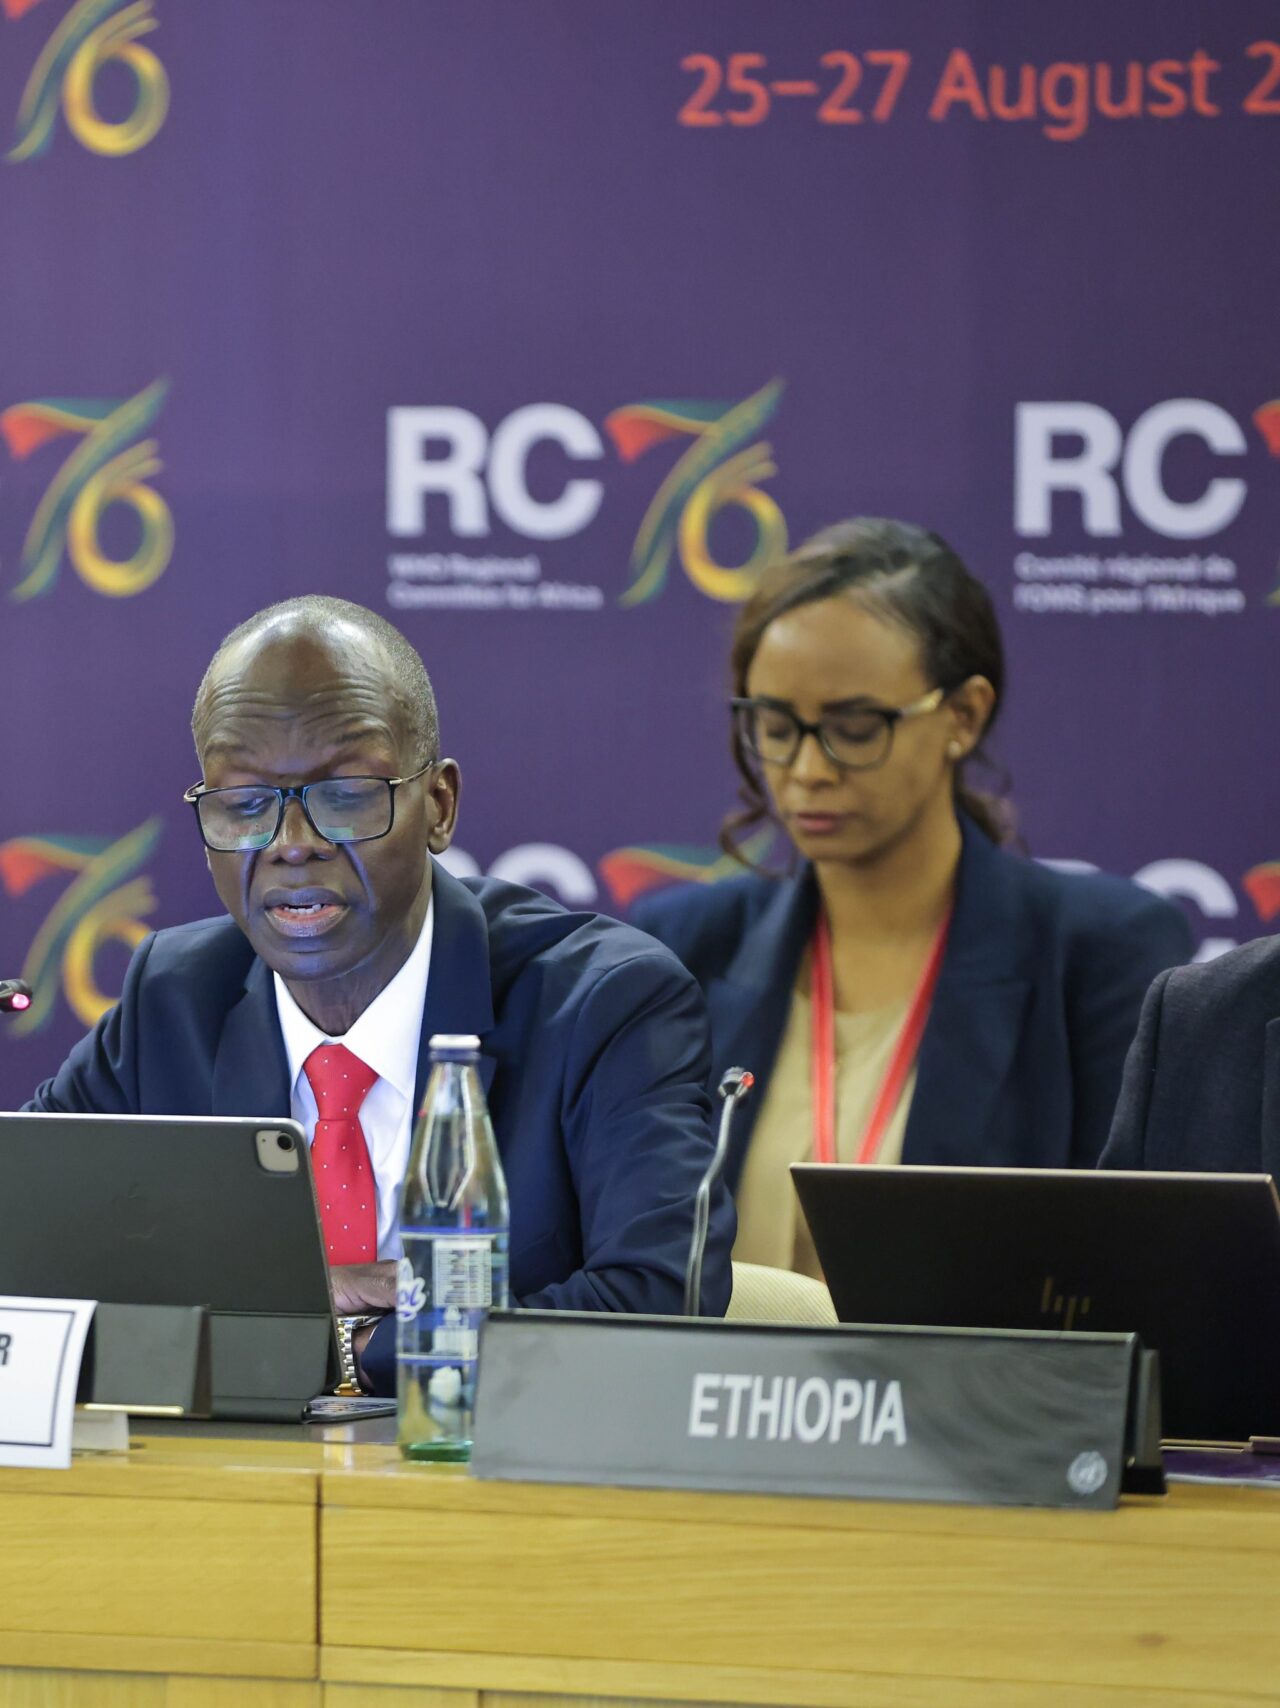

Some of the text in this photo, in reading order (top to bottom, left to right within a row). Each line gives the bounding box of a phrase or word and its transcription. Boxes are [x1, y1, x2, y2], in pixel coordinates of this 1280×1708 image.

[678, 50, 912, 127] 25–27
[928, 46, 1221, 142] August
[688, 1372, 908, 1448] ETHIOPIA
